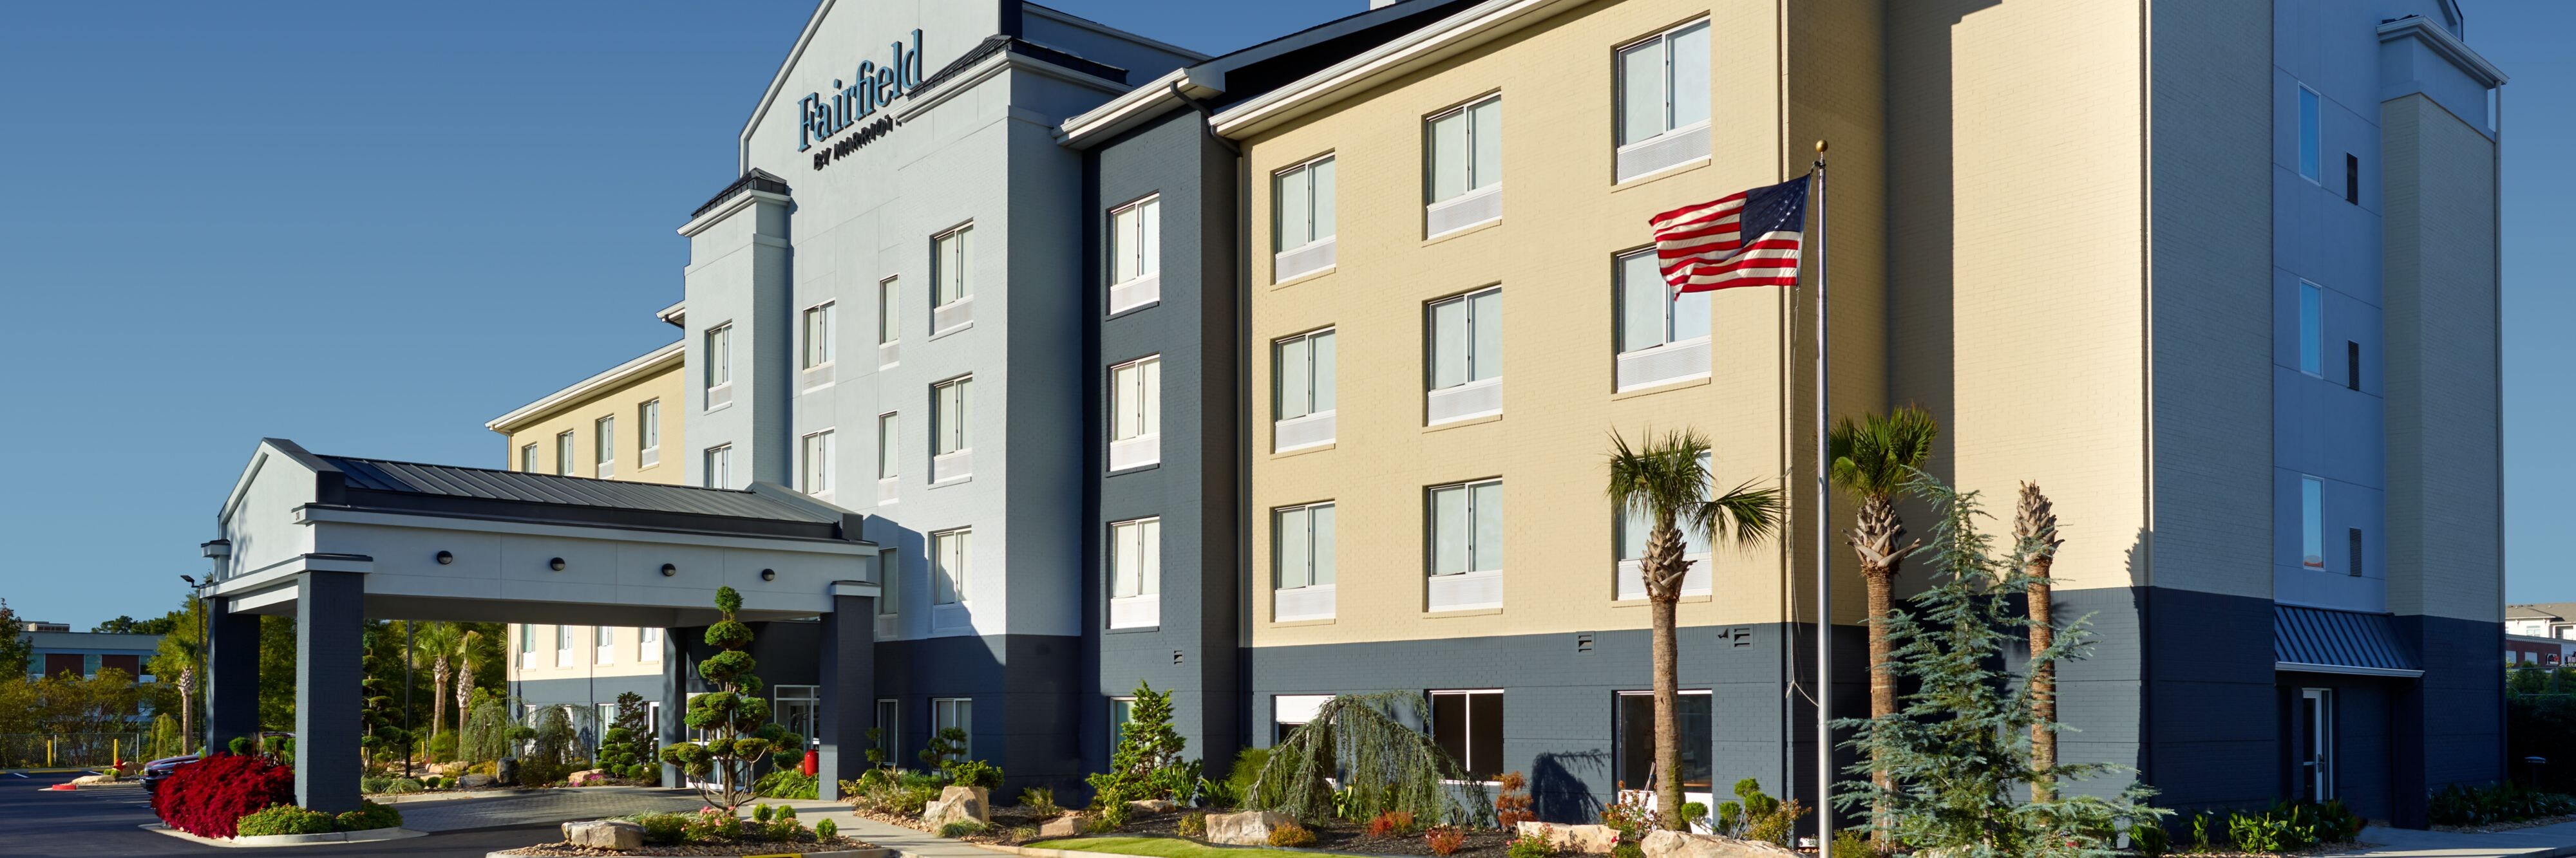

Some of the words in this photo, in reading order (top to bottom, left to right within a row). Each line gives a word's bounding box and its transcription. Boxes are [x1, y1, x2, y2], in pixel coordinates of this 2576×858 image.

[797, 28, 923, 153] Fairfield
[813, 147, 832, 171] BY
[833, 114, 902, 161] MARRIOT
